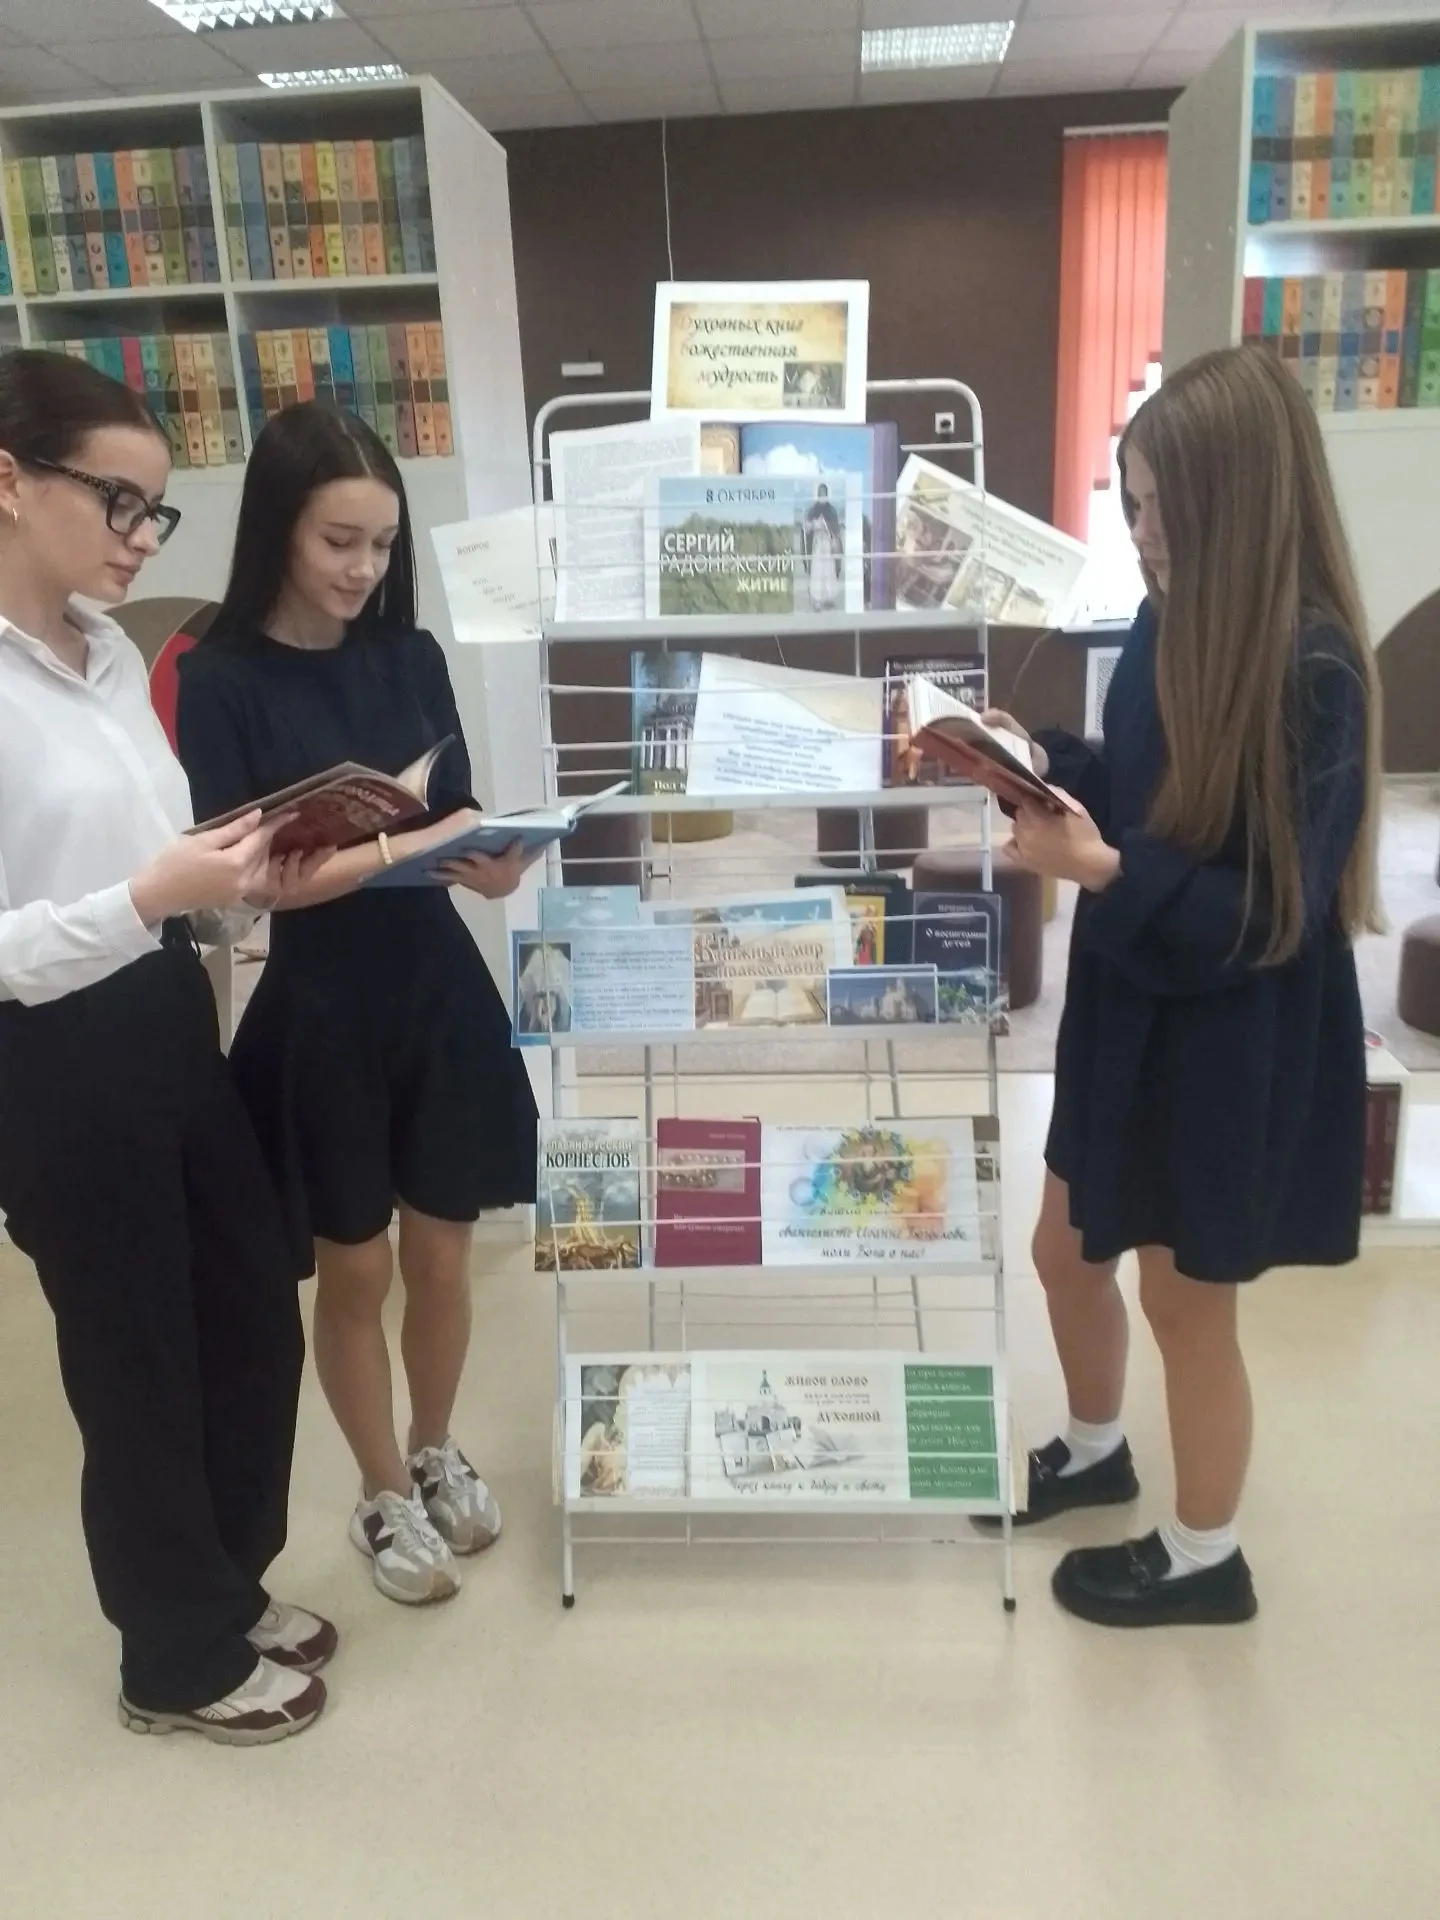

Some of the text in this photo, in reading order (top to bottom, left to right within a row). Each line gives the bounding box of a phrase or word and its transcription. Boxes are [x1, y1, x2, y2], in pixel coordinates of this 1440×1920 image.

[706, 488, 776, 503] 8 ОКТЯБРЯ
[664, 530, 735, 553] СЕРГИЙ
[659, 550, 795, 577] РАДОНЕЖСКИЙ
[736, 577, 787, 593] ЖИТИЕ
[934, 929, 988, 939] воспитани
[790, 944, 824, 960] мир
[545, 1152, 631, 1168] КОРНЕСЛОВ
